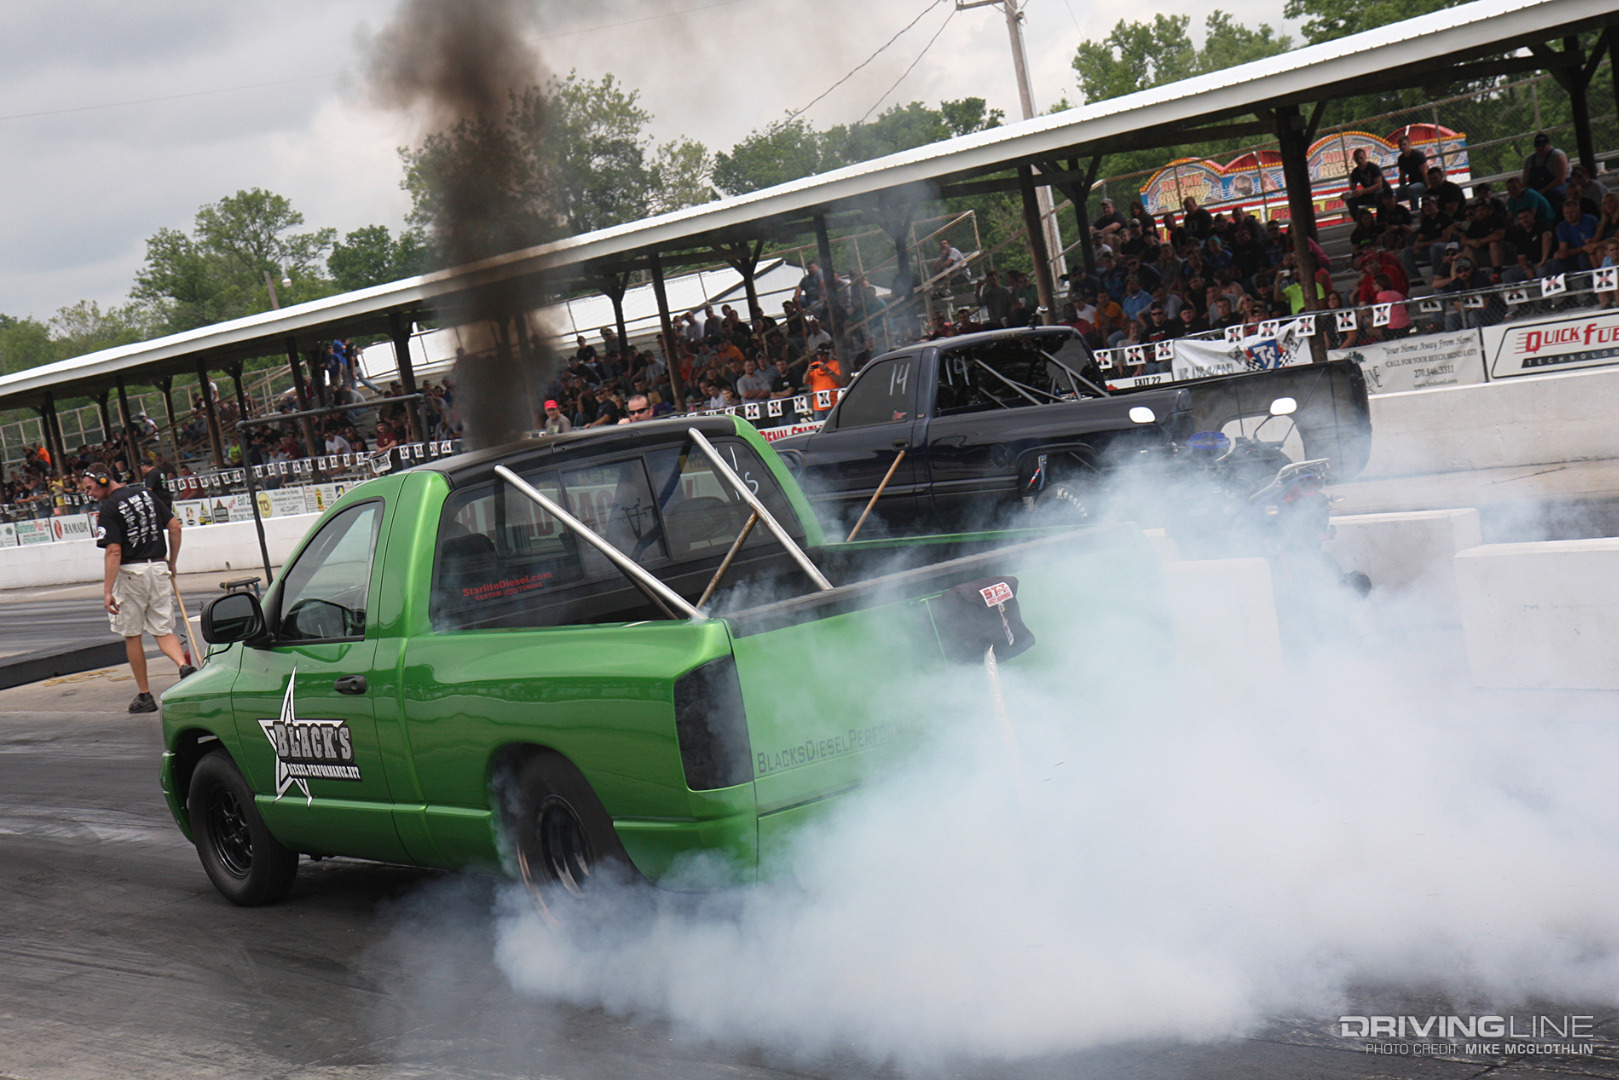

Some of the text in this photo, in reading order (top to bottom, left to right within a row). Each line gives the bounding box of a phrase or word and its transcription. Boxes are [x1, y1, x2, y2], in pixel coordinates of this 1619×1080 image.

[1525, 327, 1580, 354] QUICK
[946, 355, 970, 386] 14
[1385, 359, 1401, 368] CALL
[889, 362, 911, 396] 14
[1134, 377, 1150, 386] EXIT
[64, 522, 88, 534] RAMADA
[462, 572, 553, 597] StarliteDiesel.com
[475, 591, 501, 601] CUSTOM
[518, 582, 543, 592] TUNING
[274, 724, 352, 760] BLACK'S
